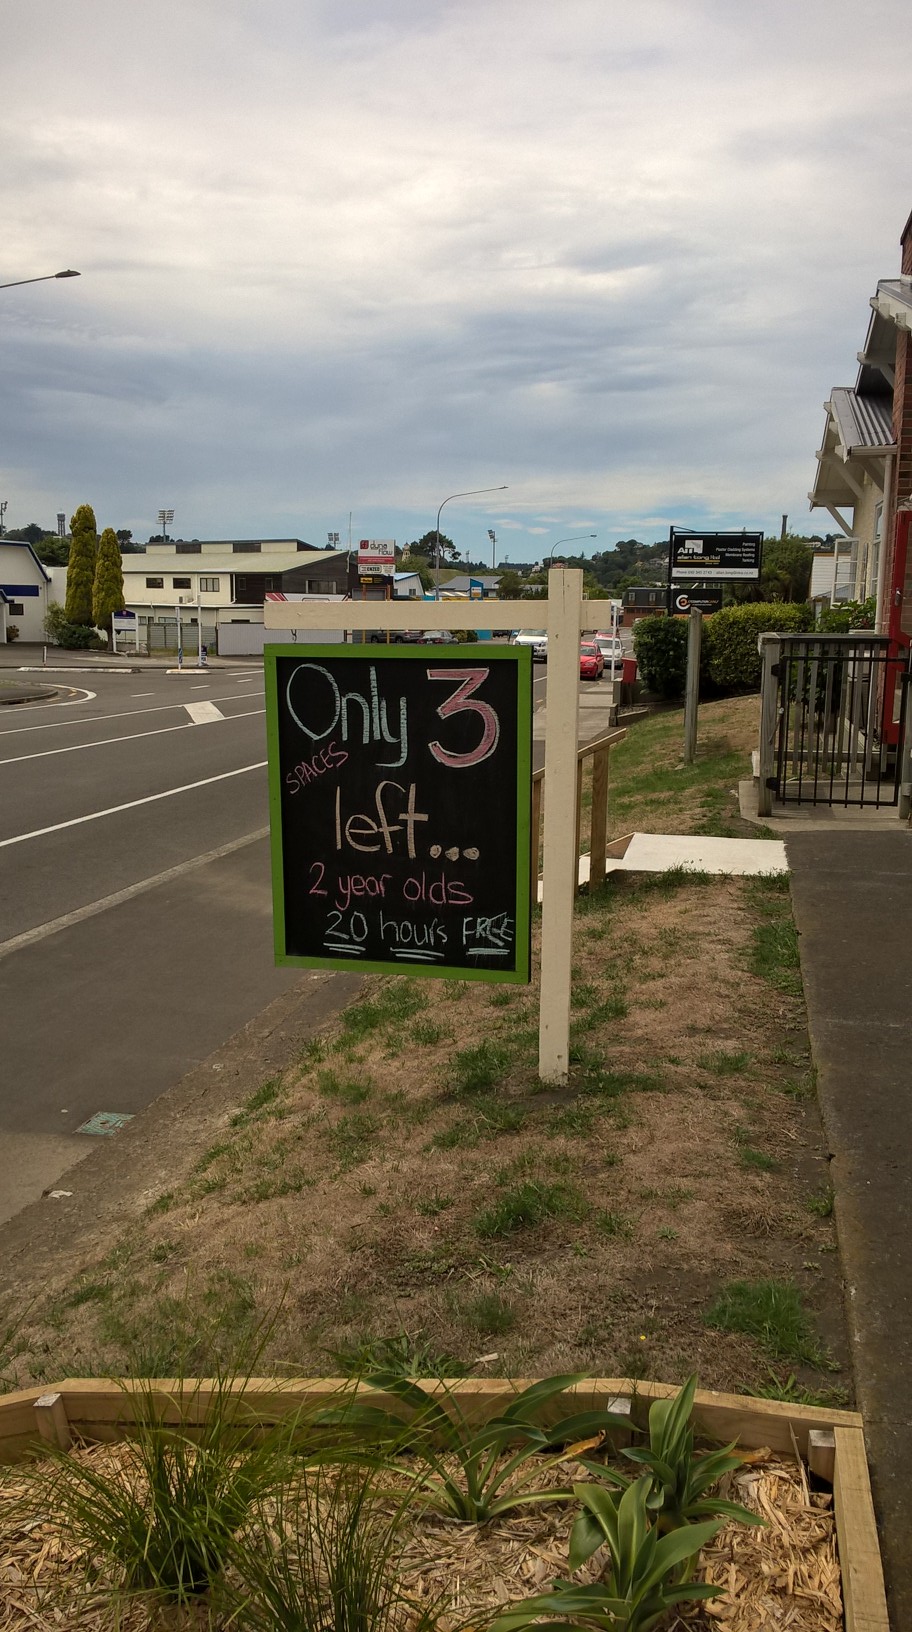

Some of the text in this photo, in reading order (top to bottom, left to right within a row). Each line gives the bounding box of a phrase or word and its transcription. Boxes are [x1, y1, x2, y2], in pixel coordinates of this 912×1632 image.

[286, 663, 501, 769] Only 3
[285, 741, 349, 795] SPACES
[308, 862, 474, 911] 2 year olds
[324, 909, 515, 946] 20 hours FREE
